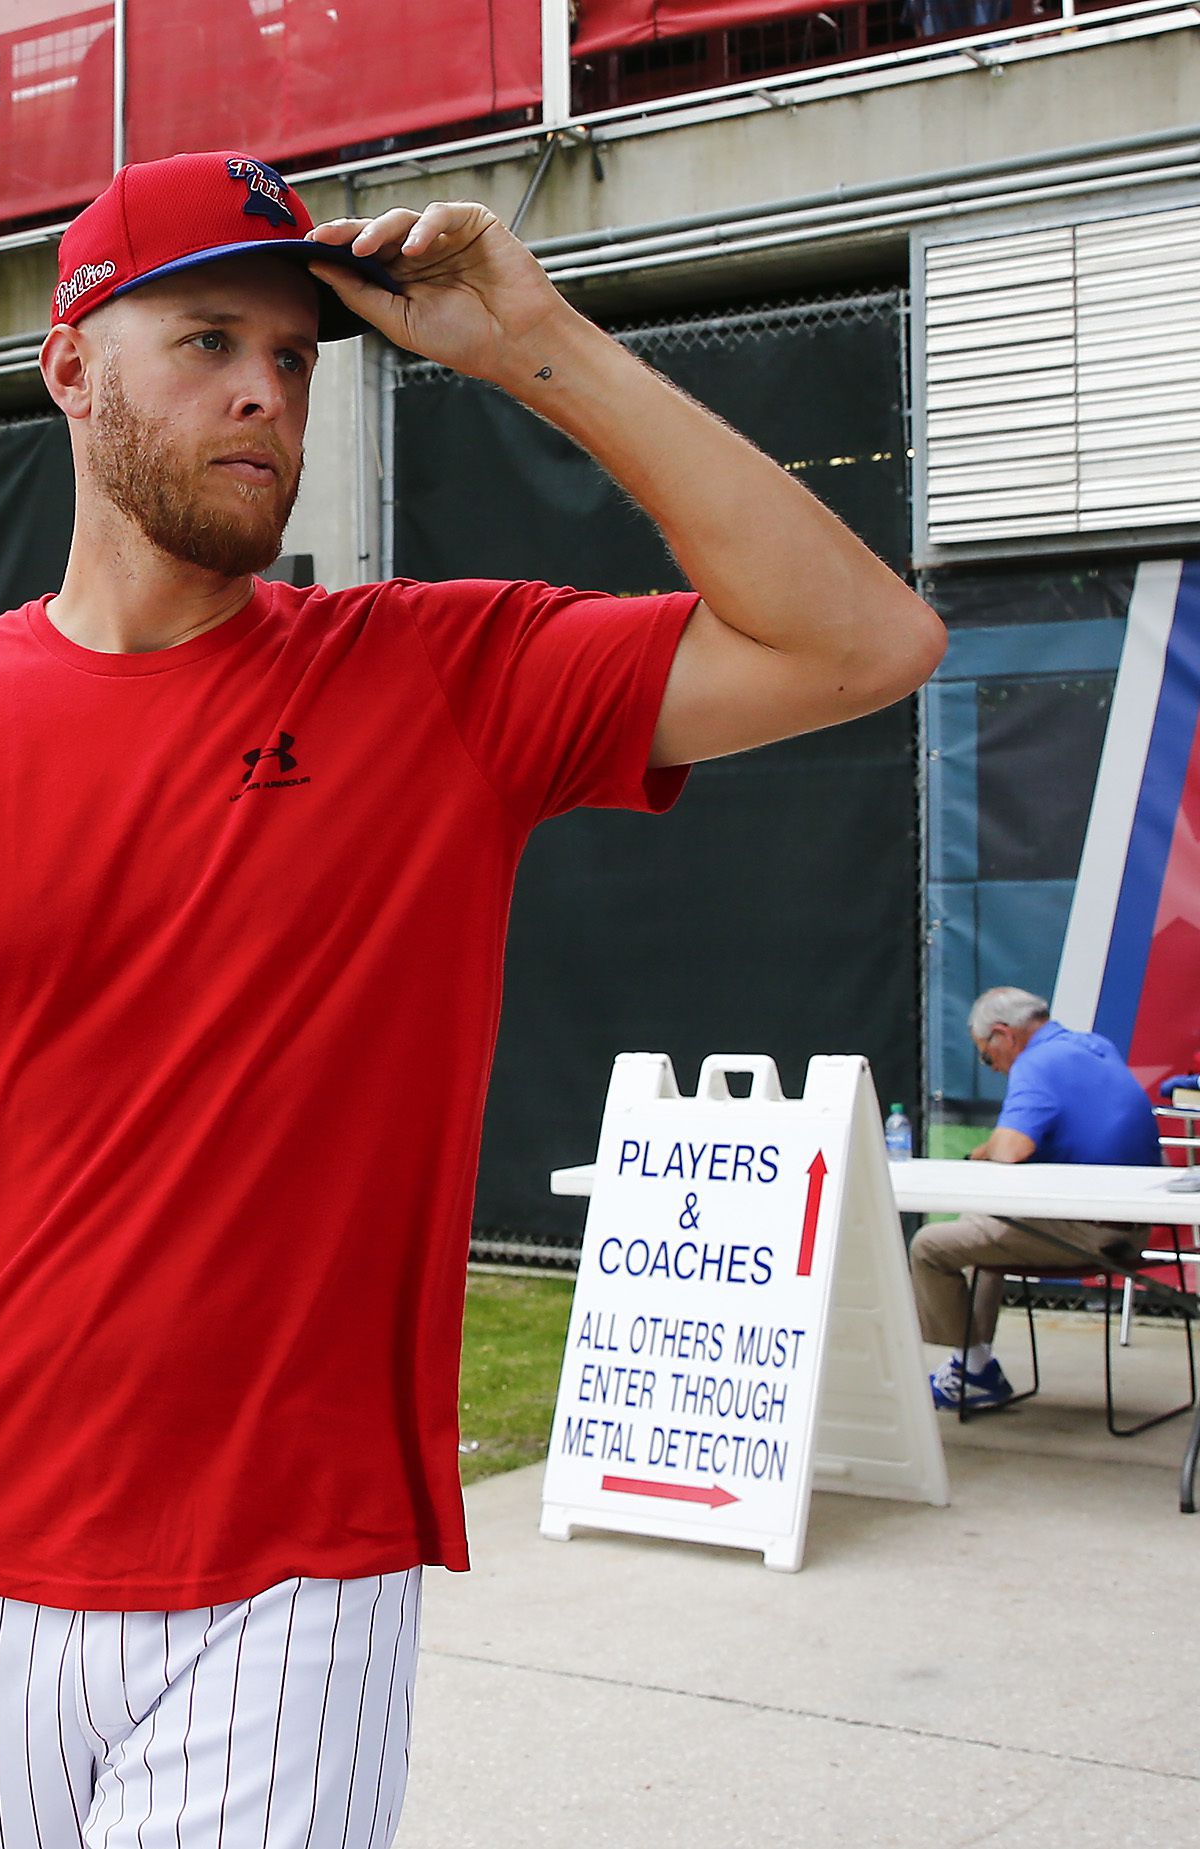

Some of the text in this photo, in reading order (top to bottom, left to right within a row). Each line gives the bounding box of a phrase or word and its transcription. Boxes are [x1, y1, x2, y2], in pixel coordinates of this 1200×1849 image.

[618, 1139, 780, 1184] PLAYERS
[679, 1192, 701, 1230] &
[599, 1237, 774, 1286] COACHES
[576, 1311, 806, 1370] ALL OTHERS MUST
[578, 1363, 788, 1424] ENTER THROUGH
[561, 1416, 789, 1482] METAL DETECTION
